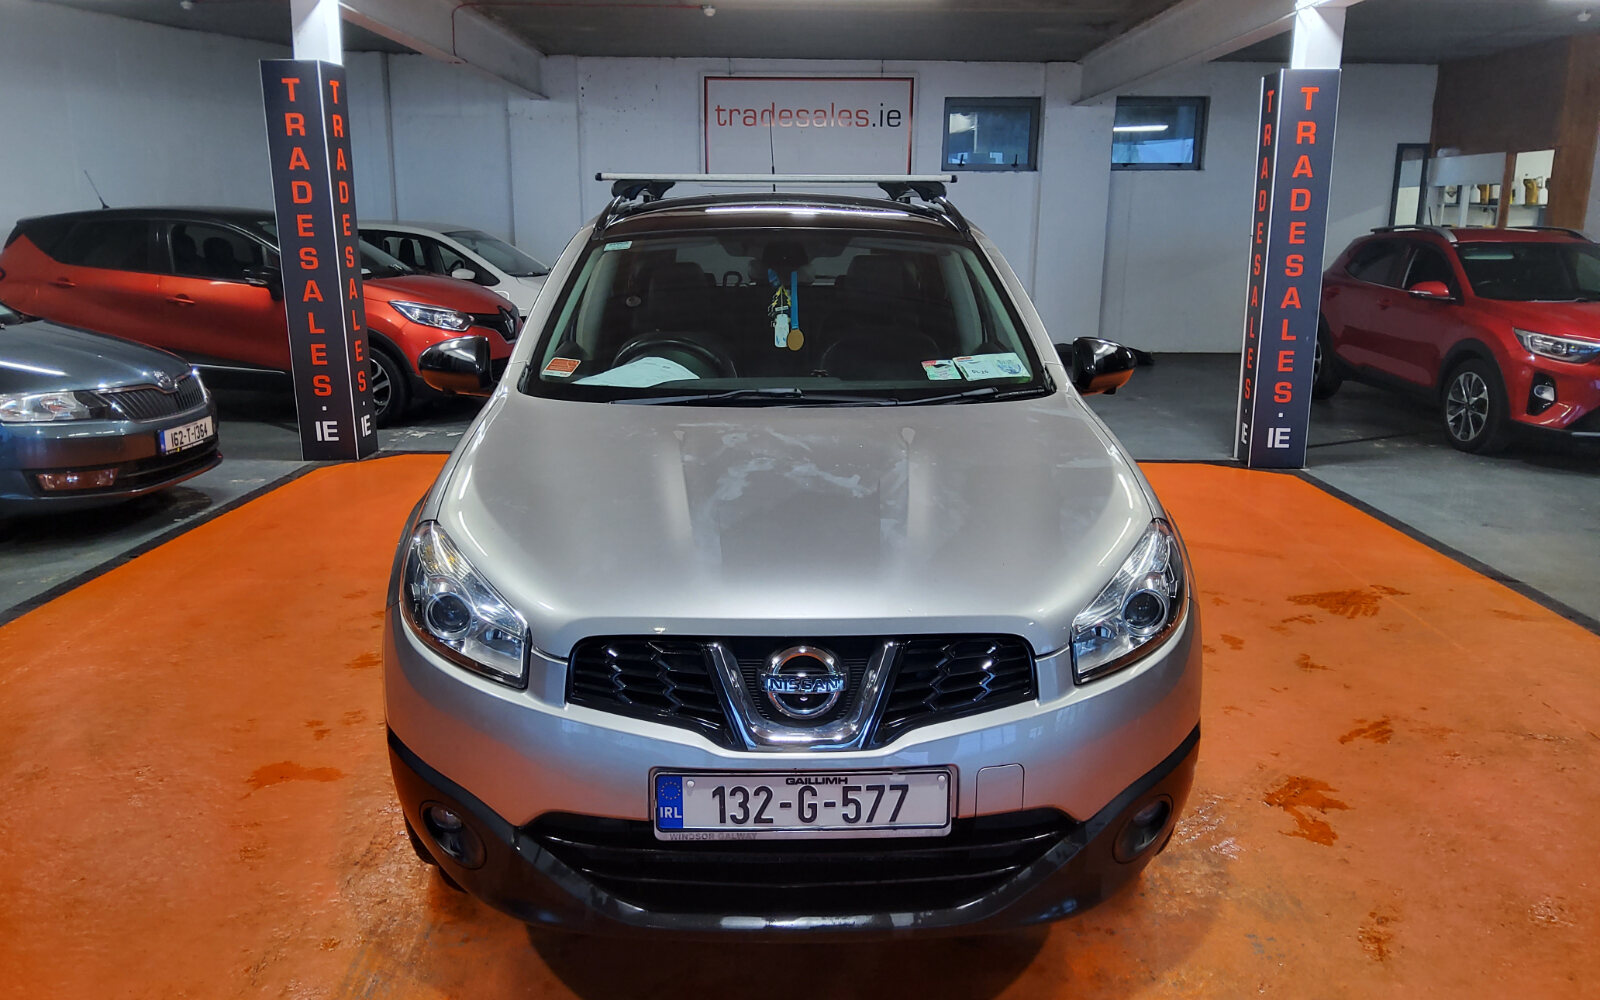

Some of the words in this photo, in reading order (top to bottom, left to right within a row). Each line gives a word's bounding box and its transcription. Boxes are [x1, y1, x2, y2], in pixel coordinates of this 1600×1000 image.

[715, 102, 902, 128] tradesales.ie
[170, 422, 208, 448] 162-T-1364
[768, 677, 840, 692] NISSAN
[786, 776, 849, 786] GAILLIMH
[712, 784, 910, 825] 132-G-577
[660, 806, 683, 819] IRL
[669, 832, 715, 841] WINDSOR
[717, 832, 758, 841] GALWAY
